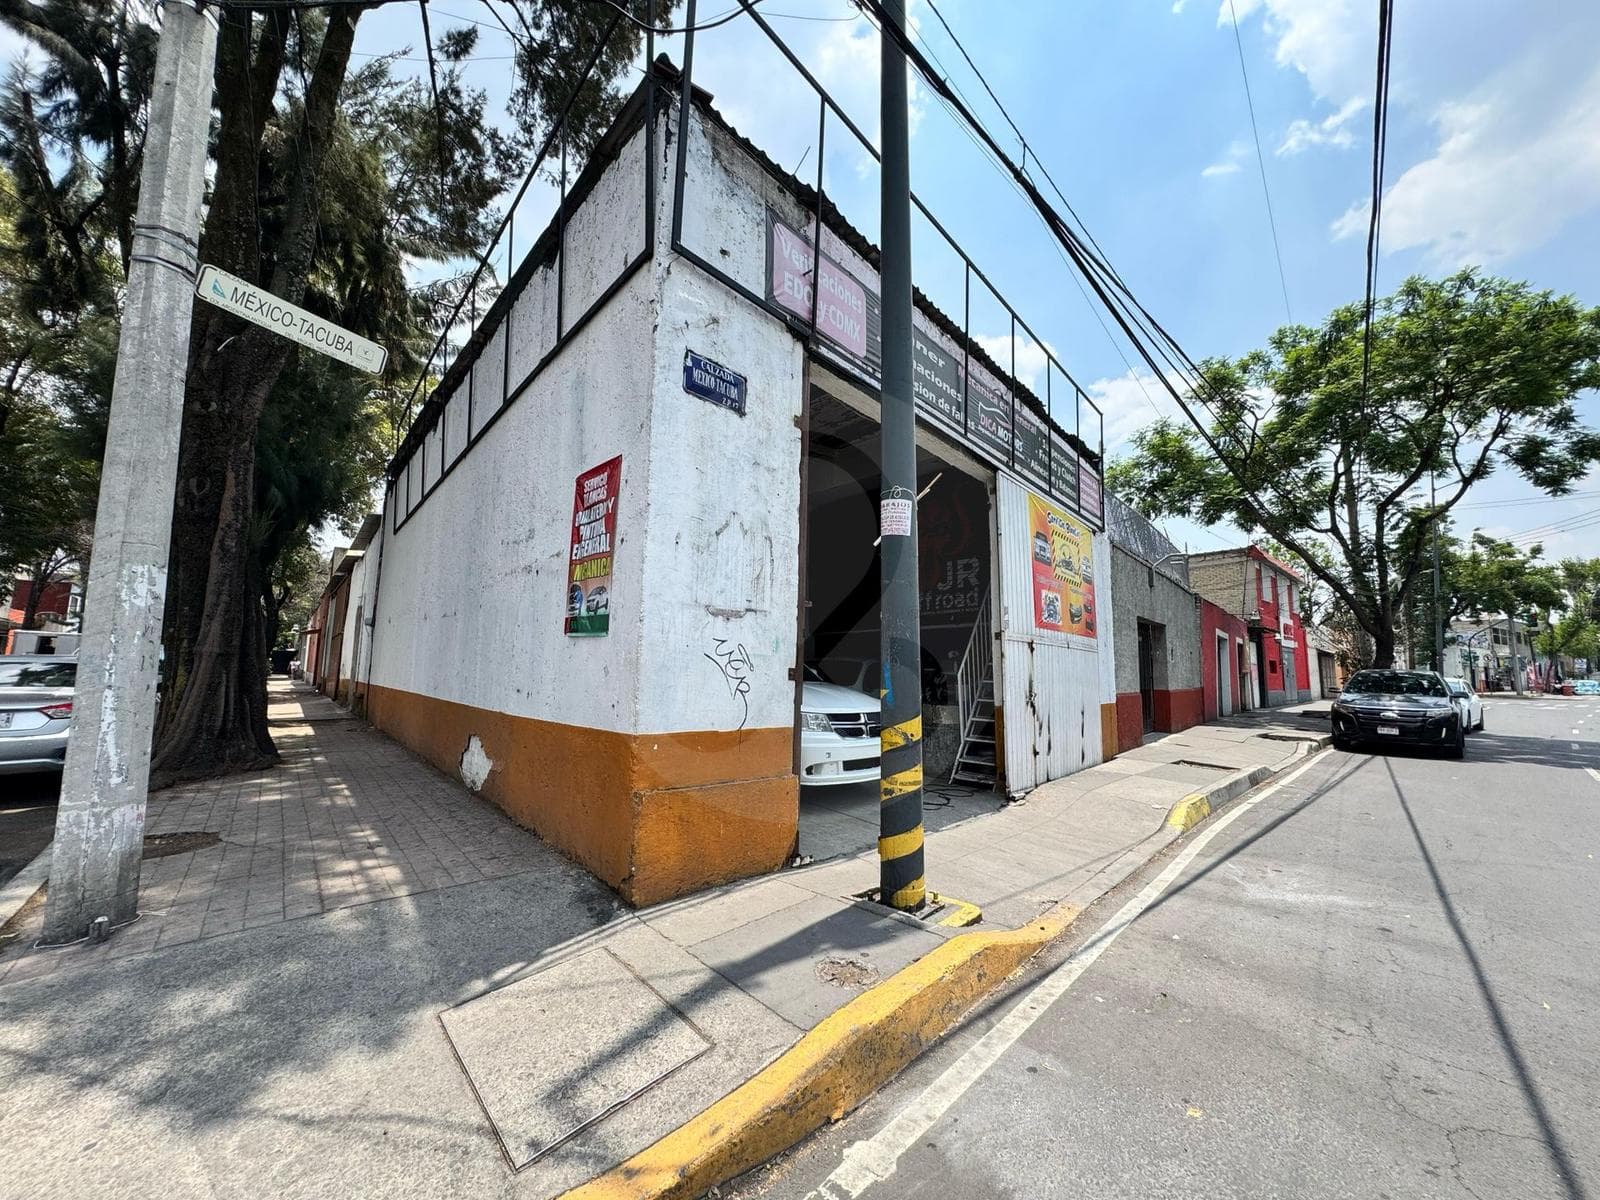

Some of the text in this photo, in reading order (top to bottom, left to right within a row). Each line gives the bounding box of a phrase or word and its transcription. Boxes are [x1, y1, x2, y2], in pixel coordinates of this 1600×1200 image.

[230, 286, 353, 356] MÉXICO-TACUBA
[829, 305, 861, 343] CDMX
[701, 361, 735, 384] CALZADA
[938, 397, 950, 413] de
[951, 404, 975, 430] falas
[1014, 413, 1037, 435] eneral
[998, 425, 1023, 452] MOTRS
